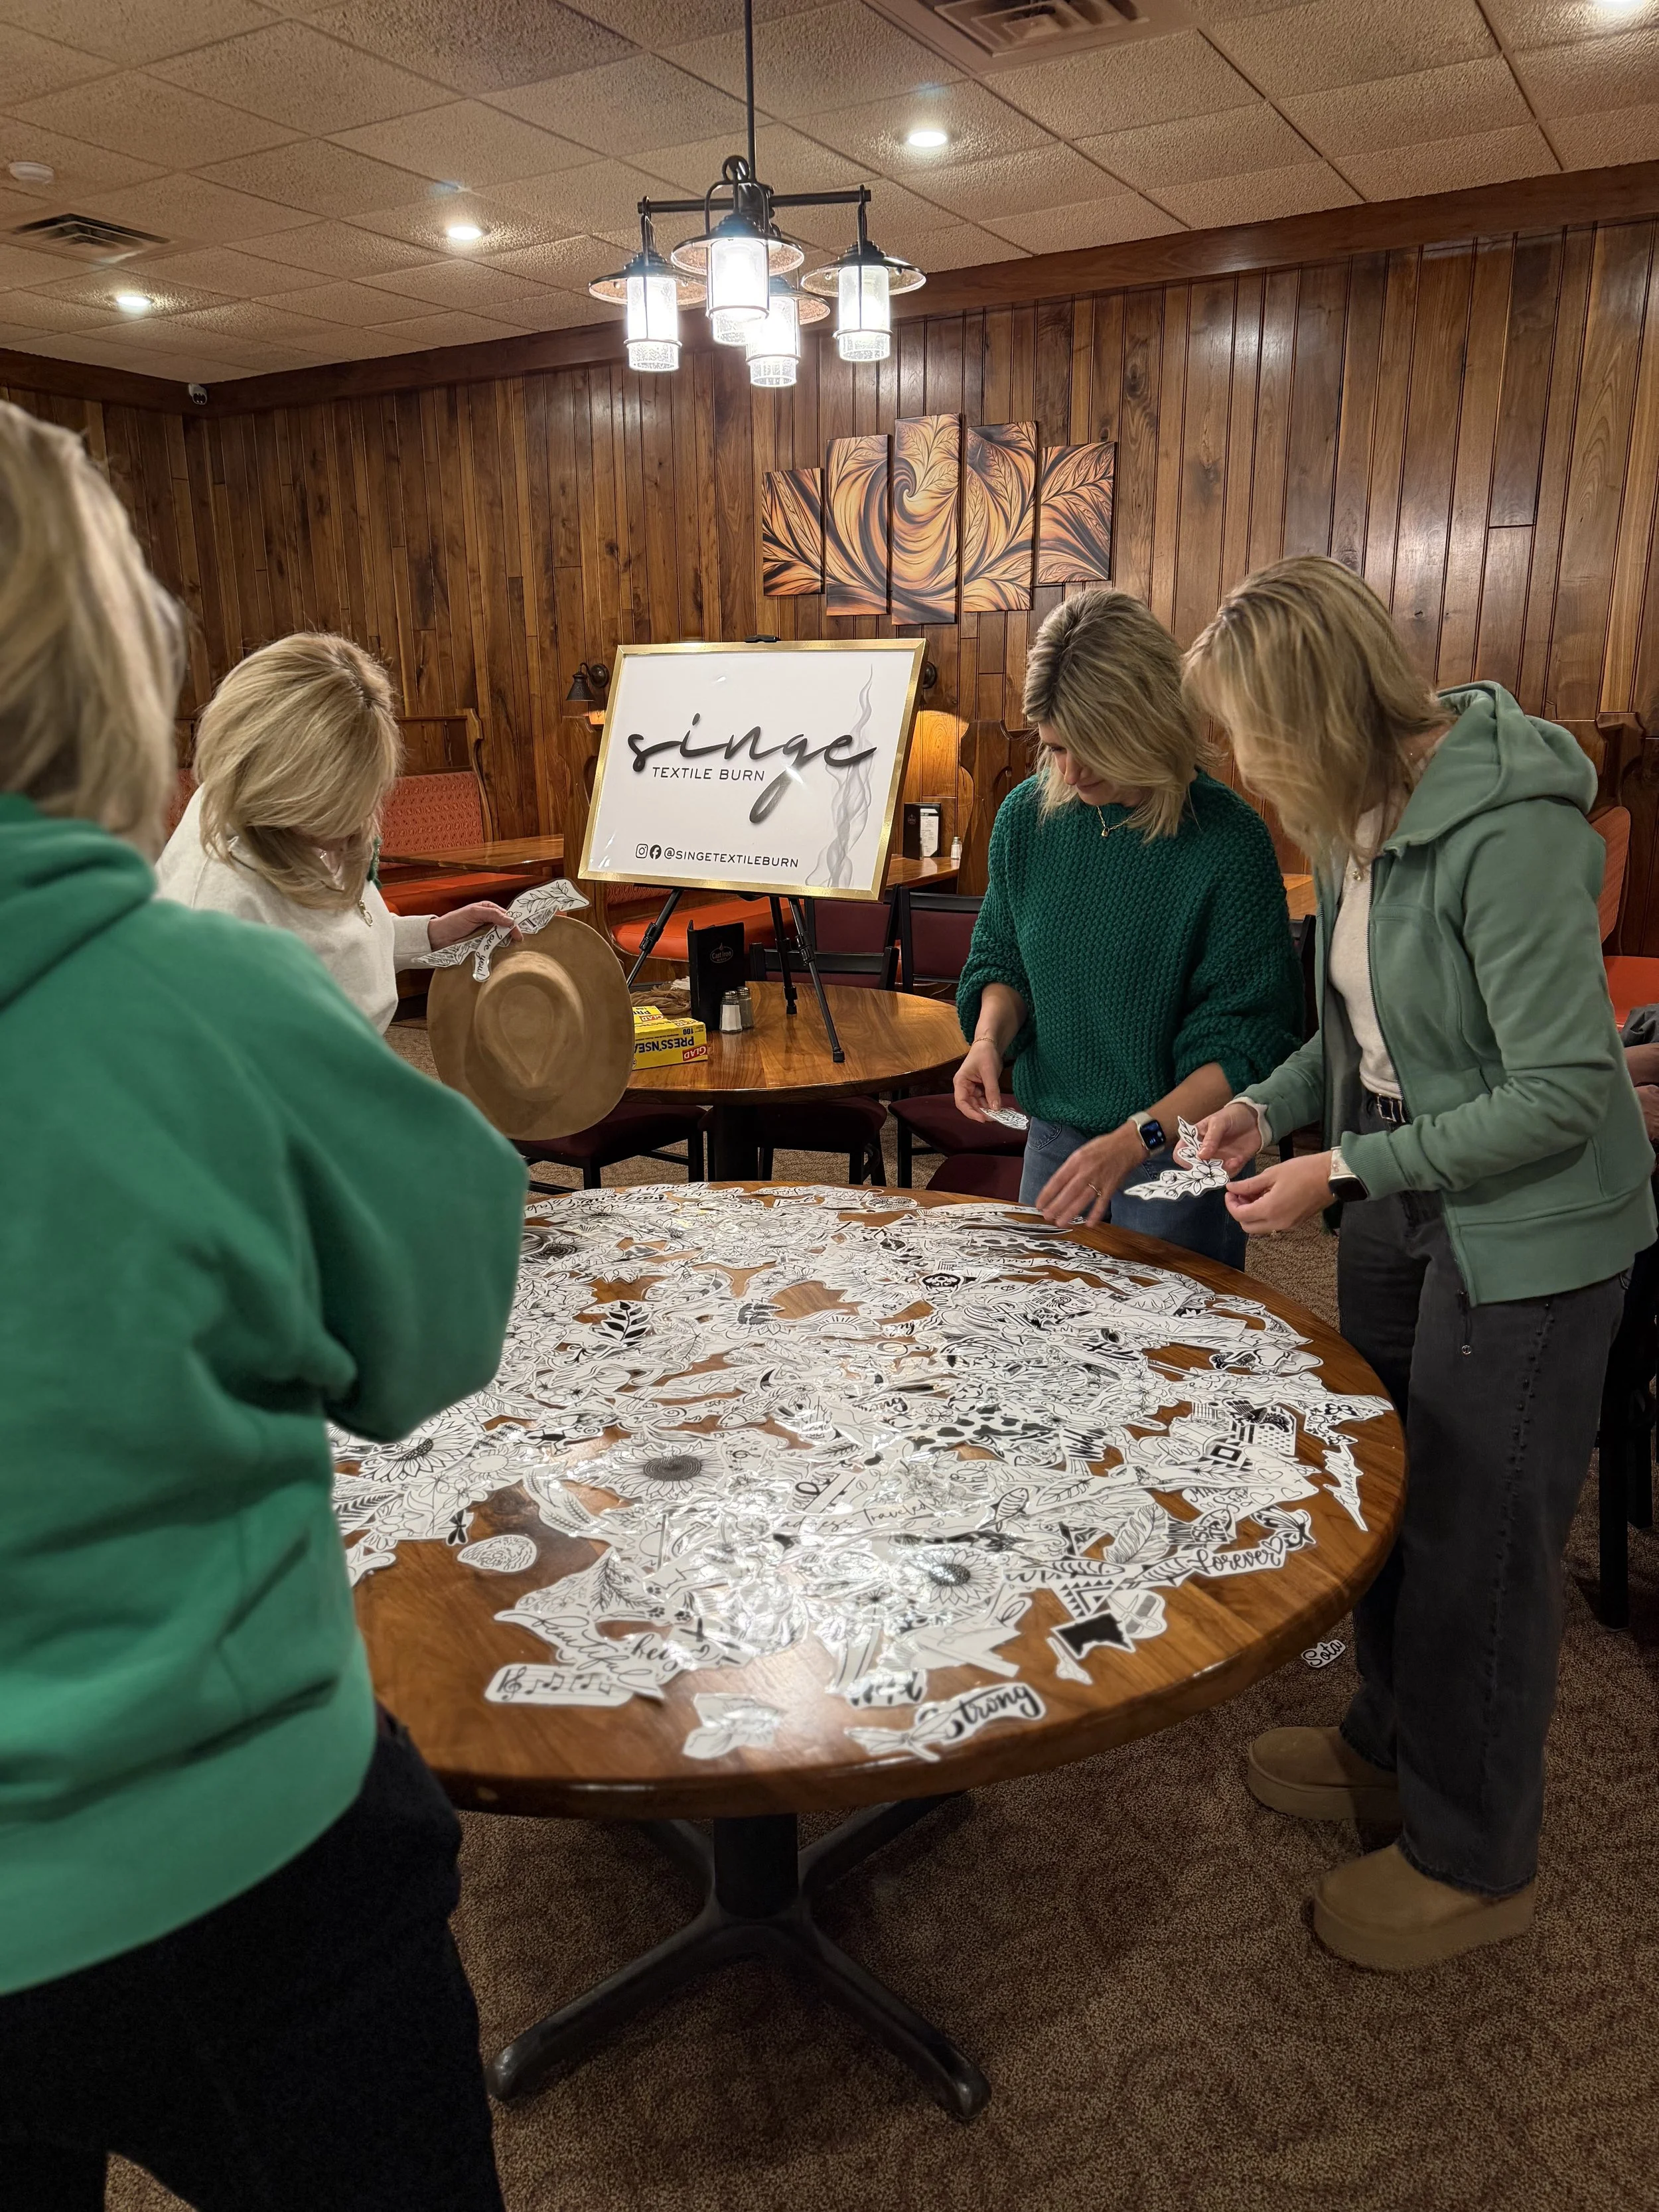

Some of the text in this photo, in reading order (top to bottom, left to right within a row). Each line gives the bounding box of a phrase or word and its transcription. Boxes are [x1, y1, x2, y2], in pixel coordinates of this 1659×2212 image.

[628, 713, 877, 824] singe
[652, 766, 765, 782] TEXTILE BURN
[664, 846, 799, 868] @SINGETEXTILEBURN
[684, 1045, 707, 1059] GLAD
[1302, 1641, 1342, 1666] Sota
